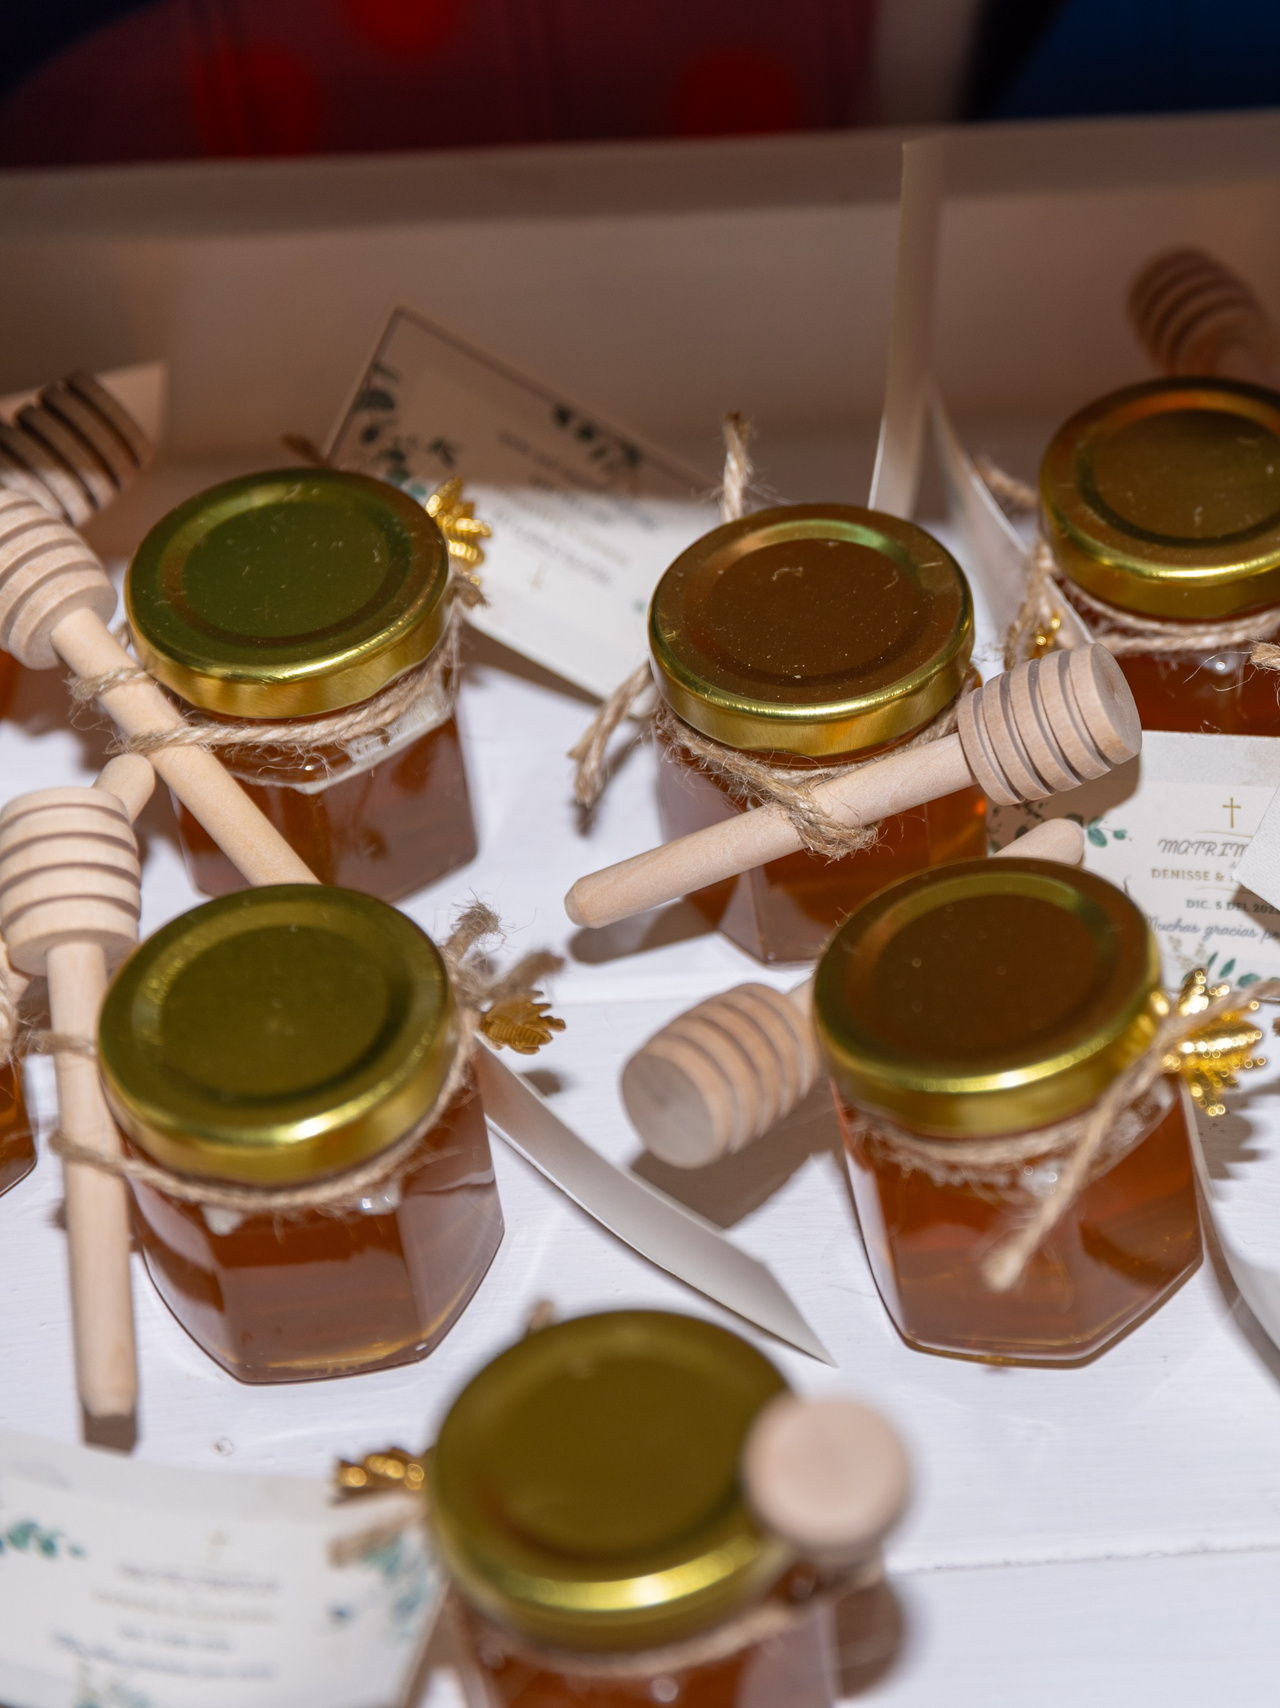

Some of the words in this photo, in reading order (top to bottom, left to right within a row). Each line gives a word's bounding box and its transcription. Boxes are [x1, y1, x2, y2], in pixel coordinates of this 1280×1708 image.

[1158, 838, 1248, 858] MATRIM
[1151, 868, 1210, 881] DENISSE
[1227, 902, 1249, 911] DEL
[1202, 924, 1259, 942] gracias
